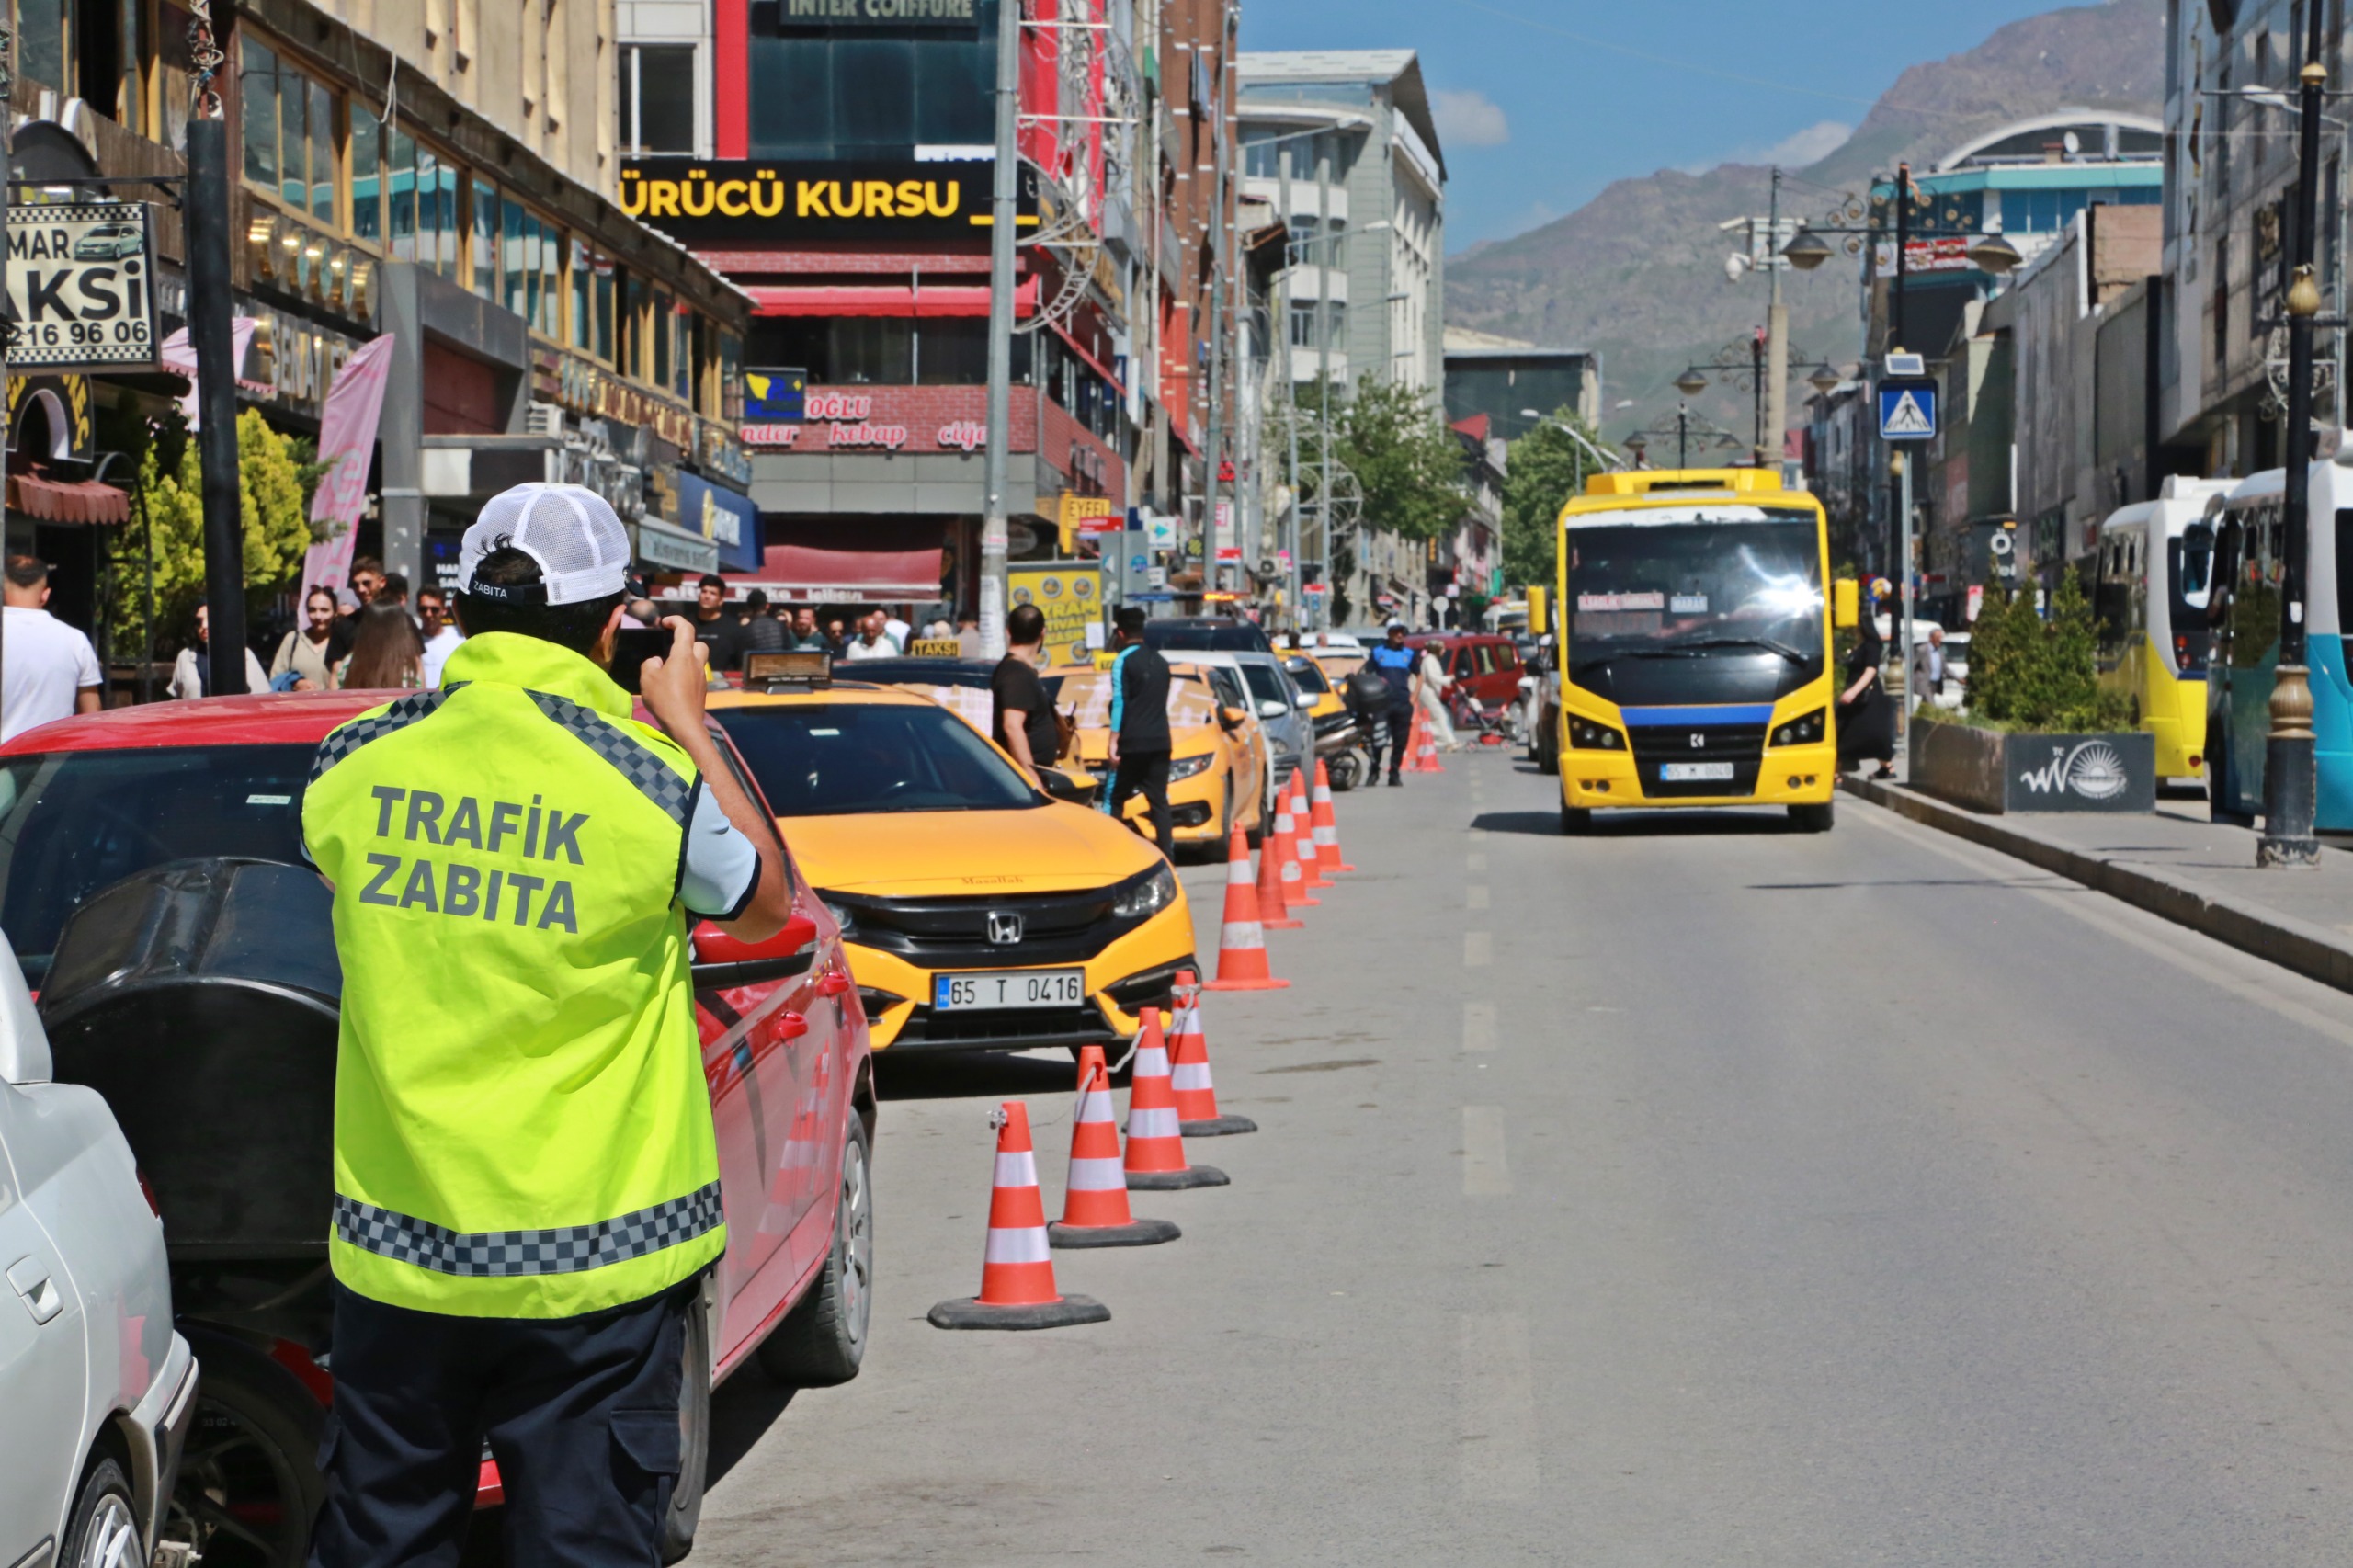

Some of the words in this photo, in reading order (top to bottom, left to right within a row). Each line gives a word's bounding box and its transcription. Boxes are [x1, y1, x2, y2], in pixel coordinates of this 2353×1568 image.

[619, 170, 785, 218] ÜRÜCÜ
[796, 180, 960, 218] KURSU
[69, 322, 104, 345] 96
[114, 321, 149, 344] 06
[806, 393, 870, 418] OĞLU
[829, 420, 906, 450] kebap
[473, 580, 508, 599] ZABITA
[370, 785, 591, 866] TRAFİK
[358, 852, 579, 934] ZABITA
[951, 981, 975, 1005] 65
[996, 979, 1007, 1003] T
[1027, 977, 1079, 1002] 0416
